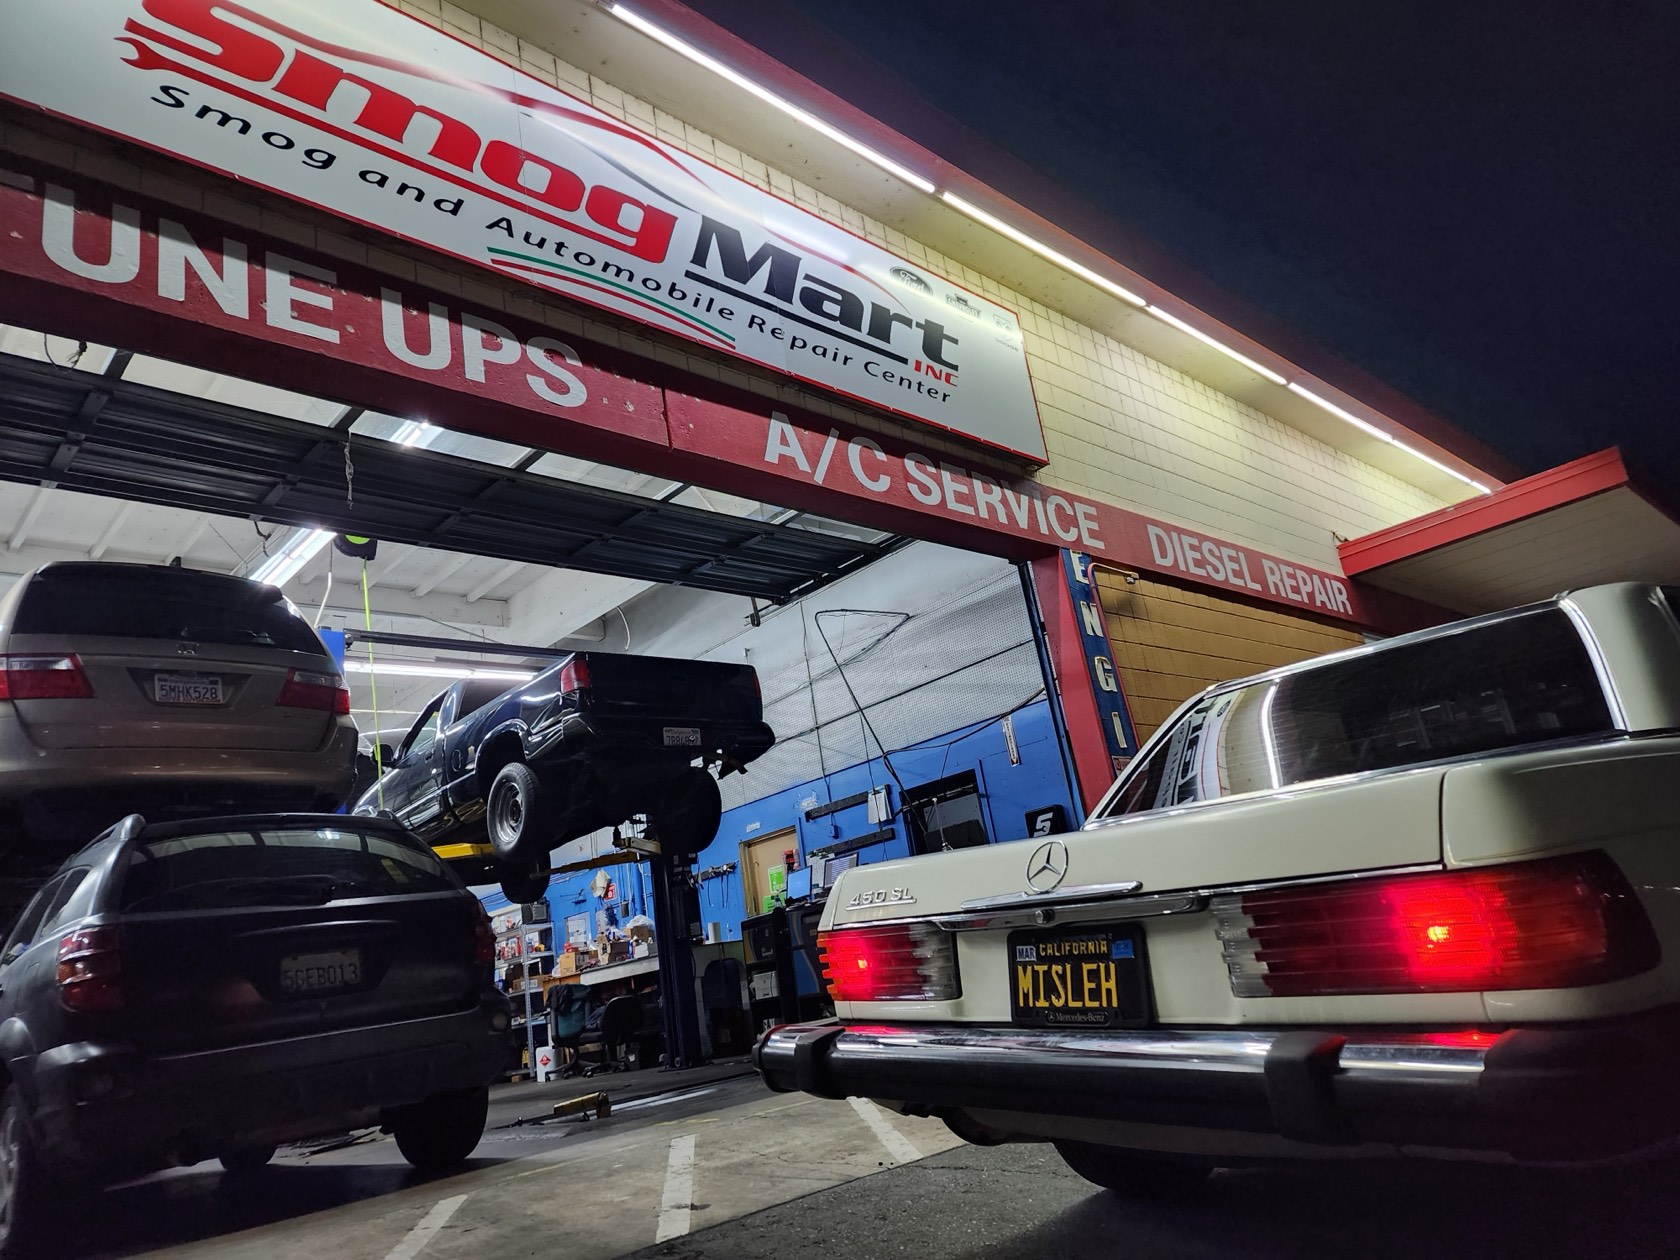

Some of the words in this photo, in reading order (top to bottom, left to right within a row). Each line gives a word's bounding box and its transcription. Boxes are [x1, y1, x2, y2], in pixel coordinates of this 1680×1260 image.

[123, 0, 678, 264] Smog
[690, 214, 960, 373] Mart
[151, 84, 337, 171] Smog
[358, 167, 465, 217] and
[485, 216, 736, 322] Automobile
[747, 315, 854, 367] Repair
[863, 361, 951, 403] Center
[0, 168, 341, 346] UNE
[380, 286, 588, 409] UPS
[914, 359, 959, 387] INC
[764, 410, 891, 492] A/C
[905, 452, 1106, 551] SERVICE
[1145, 523, 1262, 592] DIESEL
[1263, 559, 1354, 616] REPAIR
[159, 683, 218, 700] 5MHK528
[849, 888, 887, 906] 450
[890, 886, 914, 901] SL
[1017, 946, 1036, 960] MAR
[1039, 940, 1108, 957] CALIFORNIA
[1017, 961, 1119, 1008] MISLEH
[1055, 1012, 1106, 1022] Mercedes-Benz
